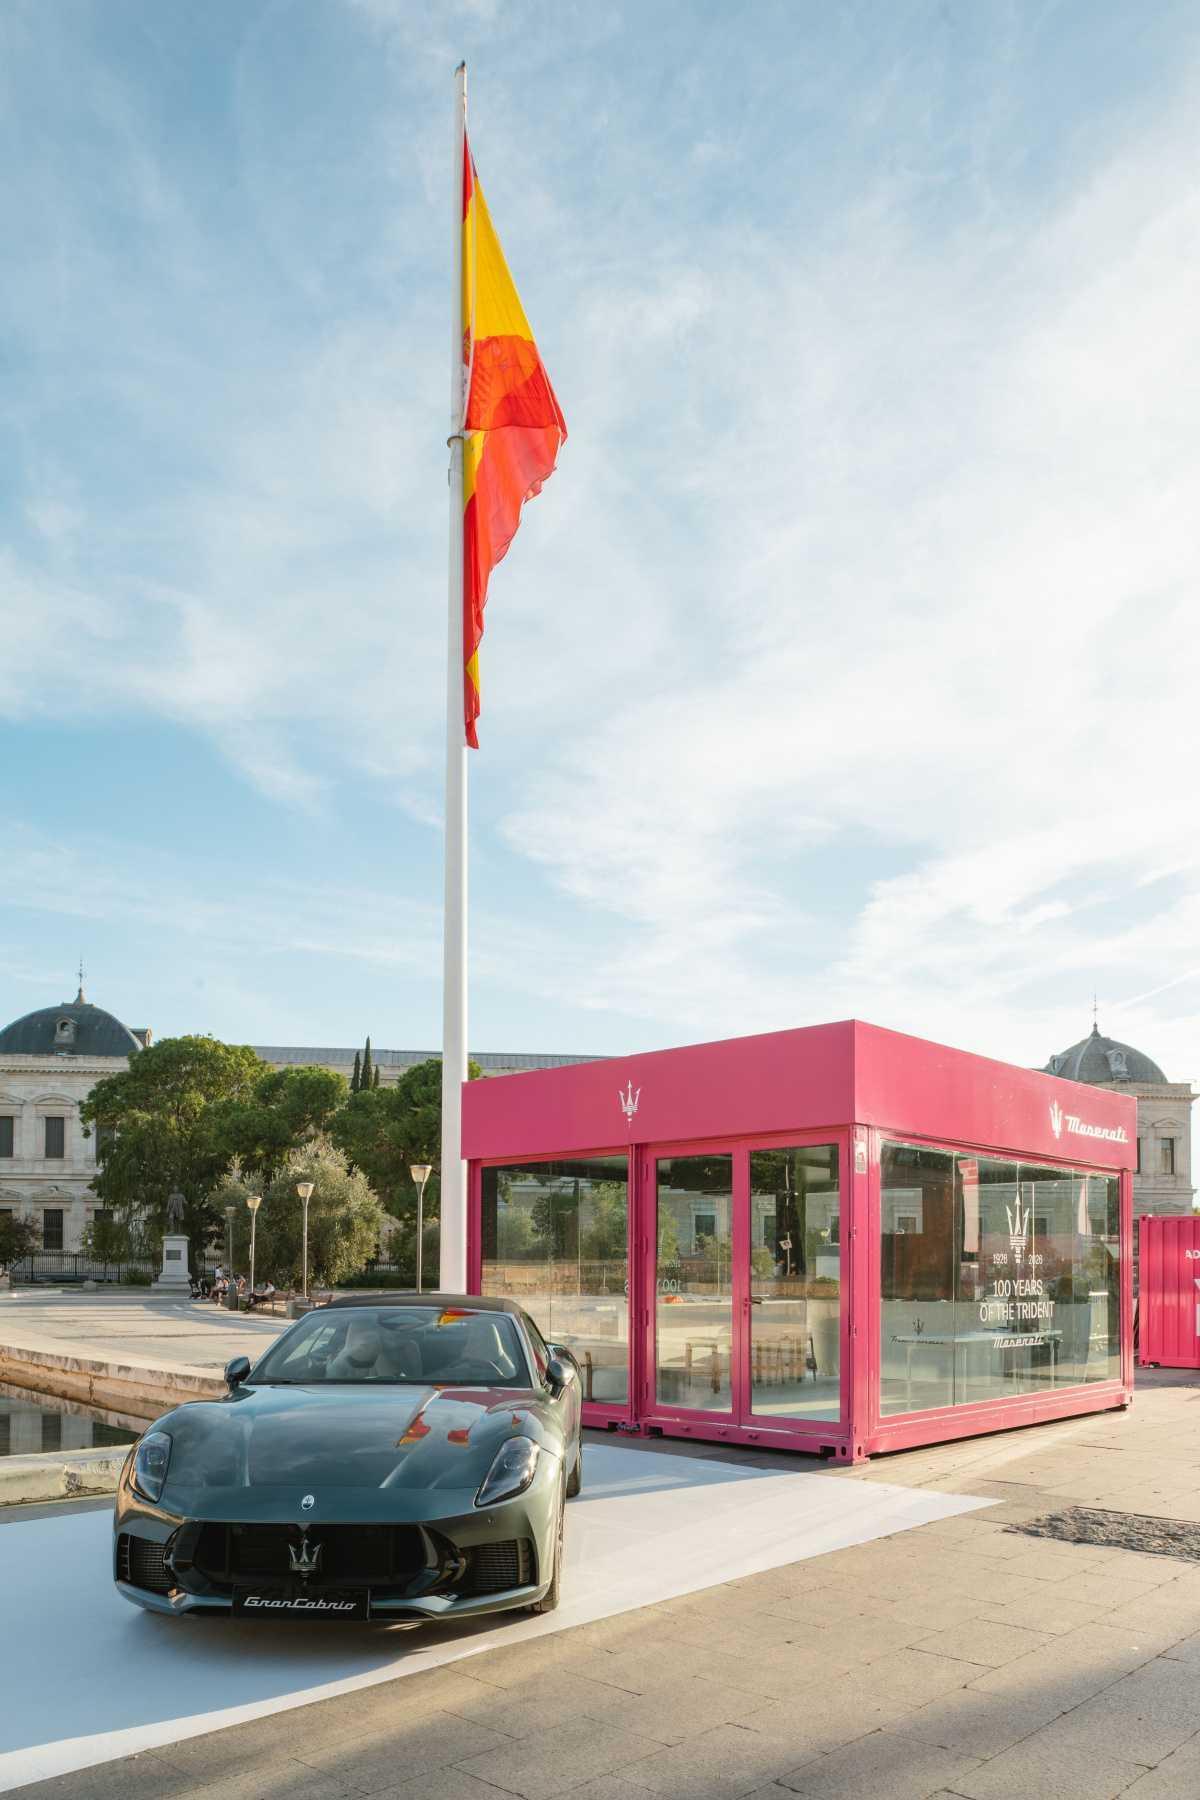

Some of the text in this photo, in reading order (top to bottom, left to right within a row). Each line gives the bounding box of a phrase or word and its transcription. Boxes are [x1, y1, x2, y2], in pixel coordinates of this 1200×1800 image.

[1064, 1115, 1128, 1143] Maserati
[993, 1279, 1043, 1297] 100 YEARS
[980, 1301, 1055, 1322] OF THE TRIDENT
[992, 1335, 1044, 1348] Maserati
[243, 1596, 356, 1610] GranCabrio
